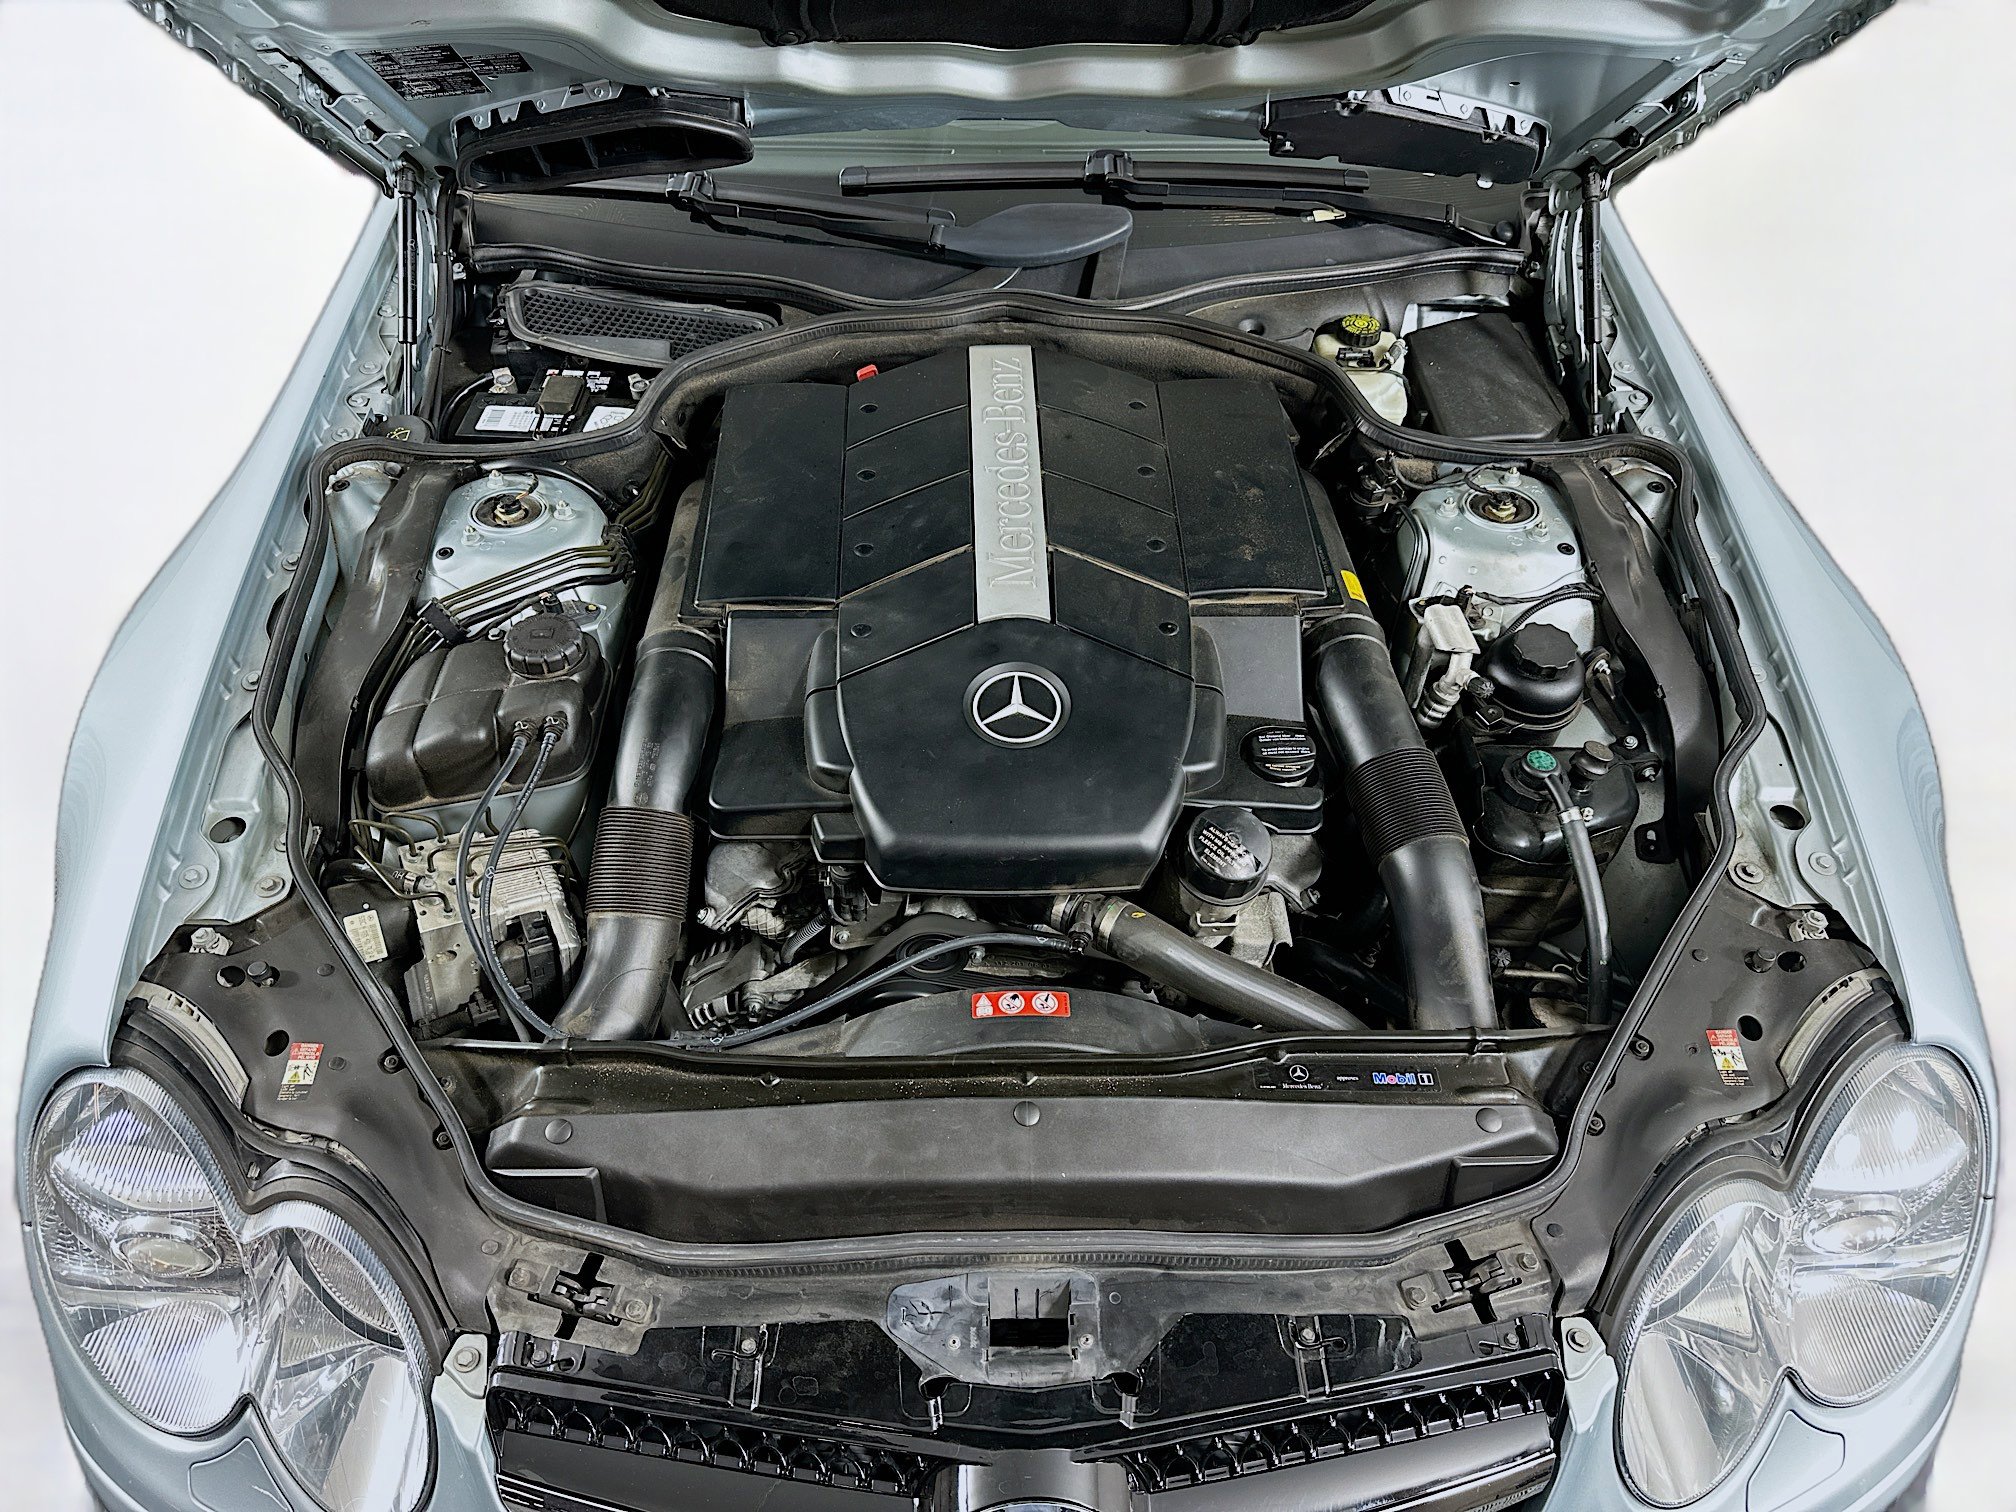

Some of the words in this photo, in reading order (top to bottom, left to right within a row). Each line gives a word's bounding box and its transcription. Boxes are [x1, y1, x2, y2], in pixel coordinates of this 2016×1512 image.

[982, 356, 1037, 589] Mercedes-Benz
[1202, 829, 1216, 842] WITH
[1214, 838, 1223, 847] MB
[1209, 826, 1228, 842] ALWAYS
[1198, 835, 1218, 851] FLEECE
[1217, 849, 1226, 858] OIL
[1203, 848, 1228, 868] ELEMENT
[1373, 1072, 1417, 1085] Mobil
